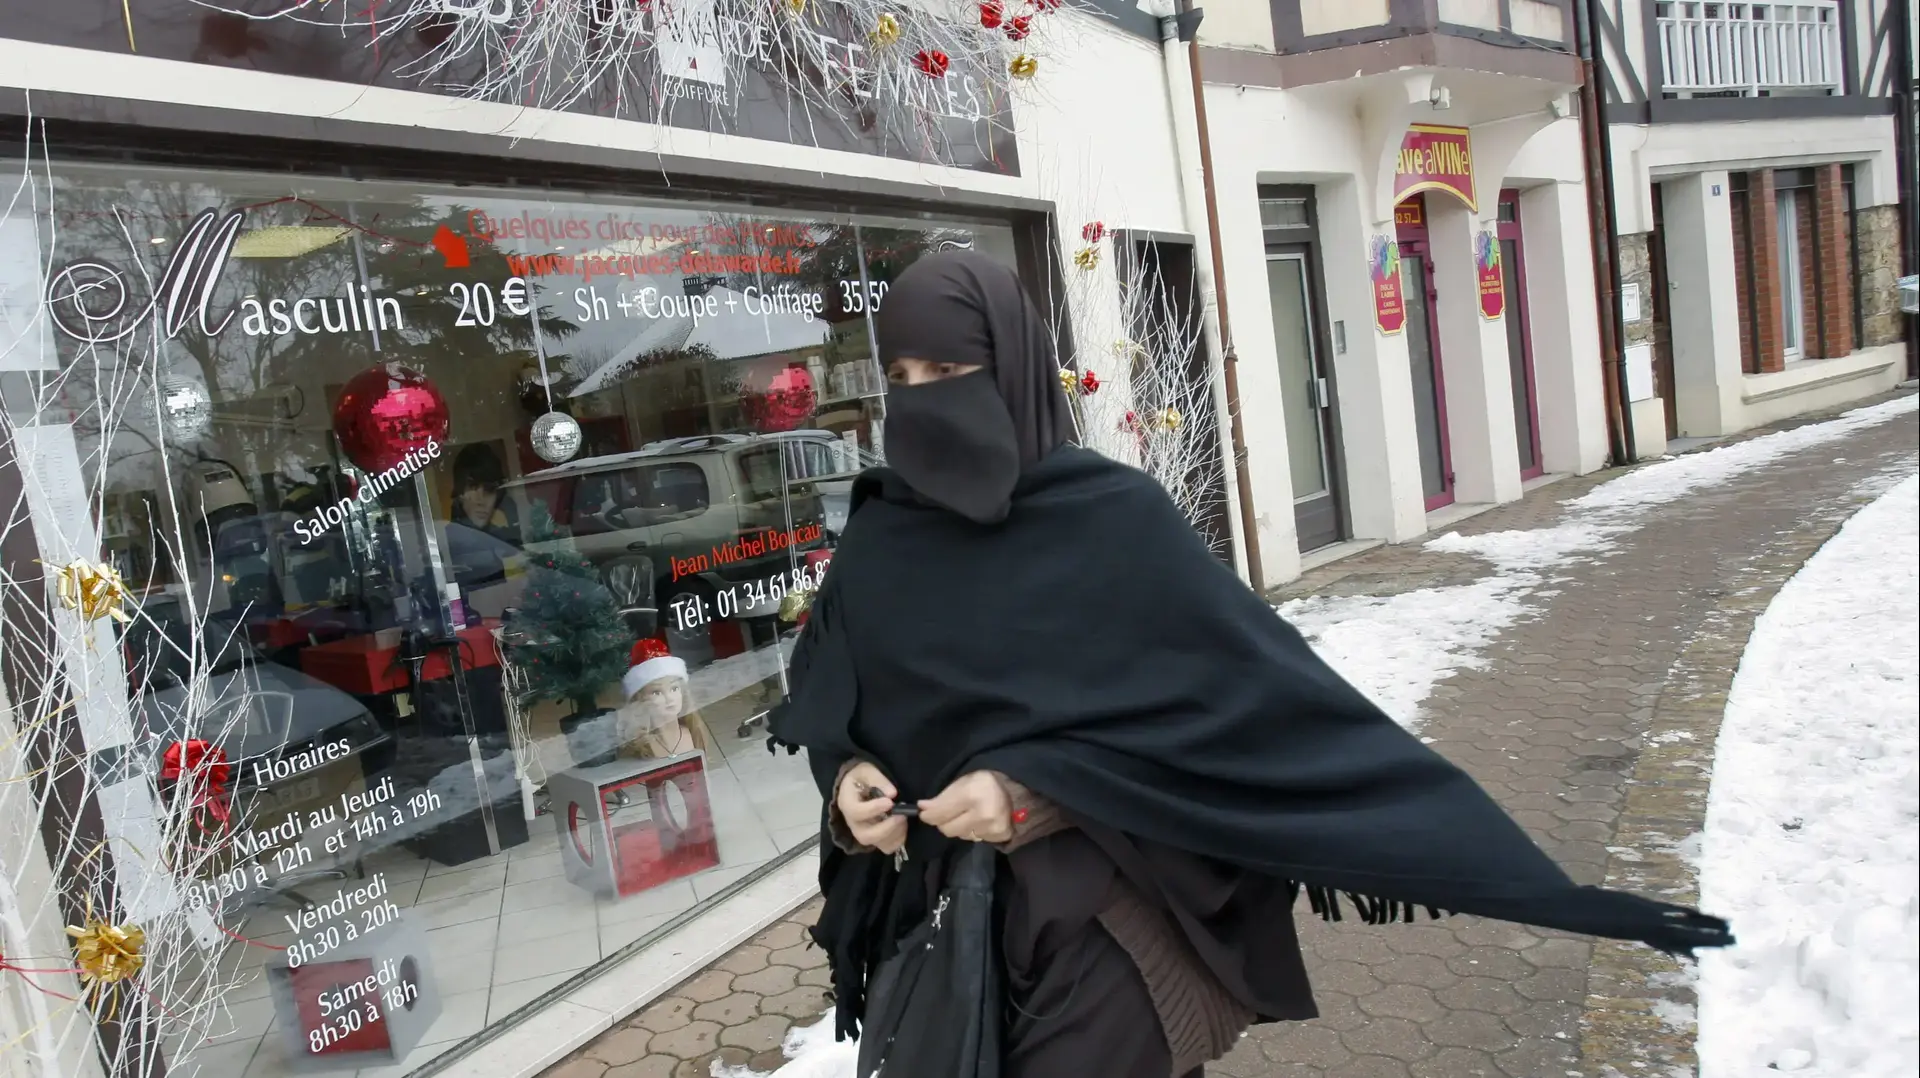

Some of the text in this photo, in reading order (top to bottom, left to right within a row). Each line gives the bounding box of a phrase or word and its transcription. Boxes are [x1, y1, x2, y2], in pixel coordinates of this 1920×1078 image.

[663, 80, 730, 107] COIFFURE
[467, 208, 817, 249] Quelques clics pour des PROMOS
[450, 282, 495, 327] 20
[501, 277, 530, 316] €
[573, 285, 610, 322] Sh
[616, 292, 633, 318] +
[640, 286, 719, 328] Coupe
[724, 291, 738, 314] +
[743, 284, 824, 323] Coiffage
[293, 435, 442, 546] Salon climatisé
[670, 523, 822, 583] Jean Michel Boucau
[670, 594, 712, 631] Tél:
[717, 587, 739, 618] 01
[743, 579, 766, 610] 34
[770, 572, 787, 601] 61
[252, 737, 352, 786] Horaires
[232, 811, 303, 860] Mardi
[308, 804, 336, 829] au
[341, 776, 396, 821] Jeudi
[188, 788, 441, 911] 8h30 à 12h et 14h à 19h
[284, 872, 388, 935] Vendredi
[286, 899, 400, 969] 8h30 à 20h
[308, 979, 418, 1053] 8h30 à 18h
[317, 957, 397, 1017] Samedi
